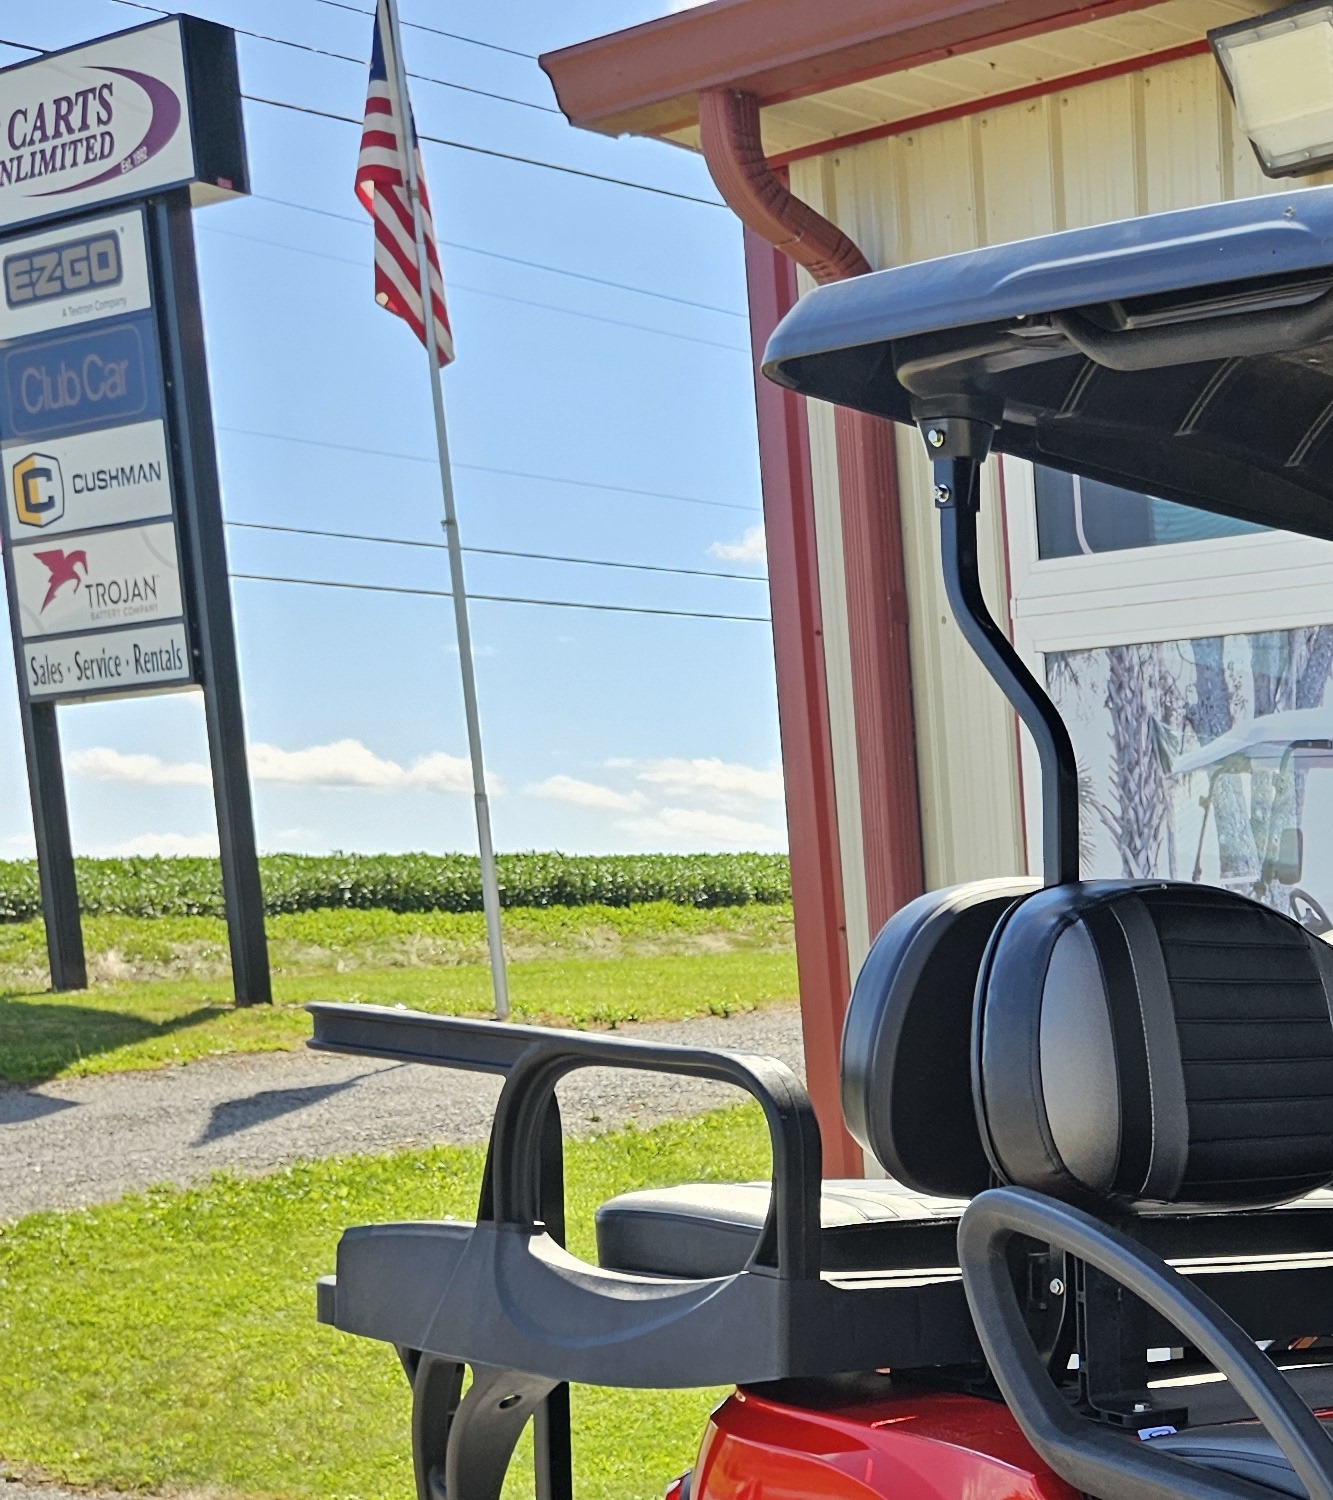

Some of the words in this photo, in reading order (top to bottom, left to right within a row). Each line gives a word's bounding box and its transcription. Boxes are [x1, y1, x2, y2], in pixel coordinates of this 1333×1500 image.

[8, 82, 113, 151] CARTS
[0, 131, 115, 187] NLIMITED
[7, 238, 118, 303] EZGO
[73, 461, 162, 494] CUSHMAN
[85, 574, 158, 608] TROJAN
[30, 655, 64, 687] Sales
[75, 647, 122, 682] Service
[133, 639, 183, 675] Rentals
